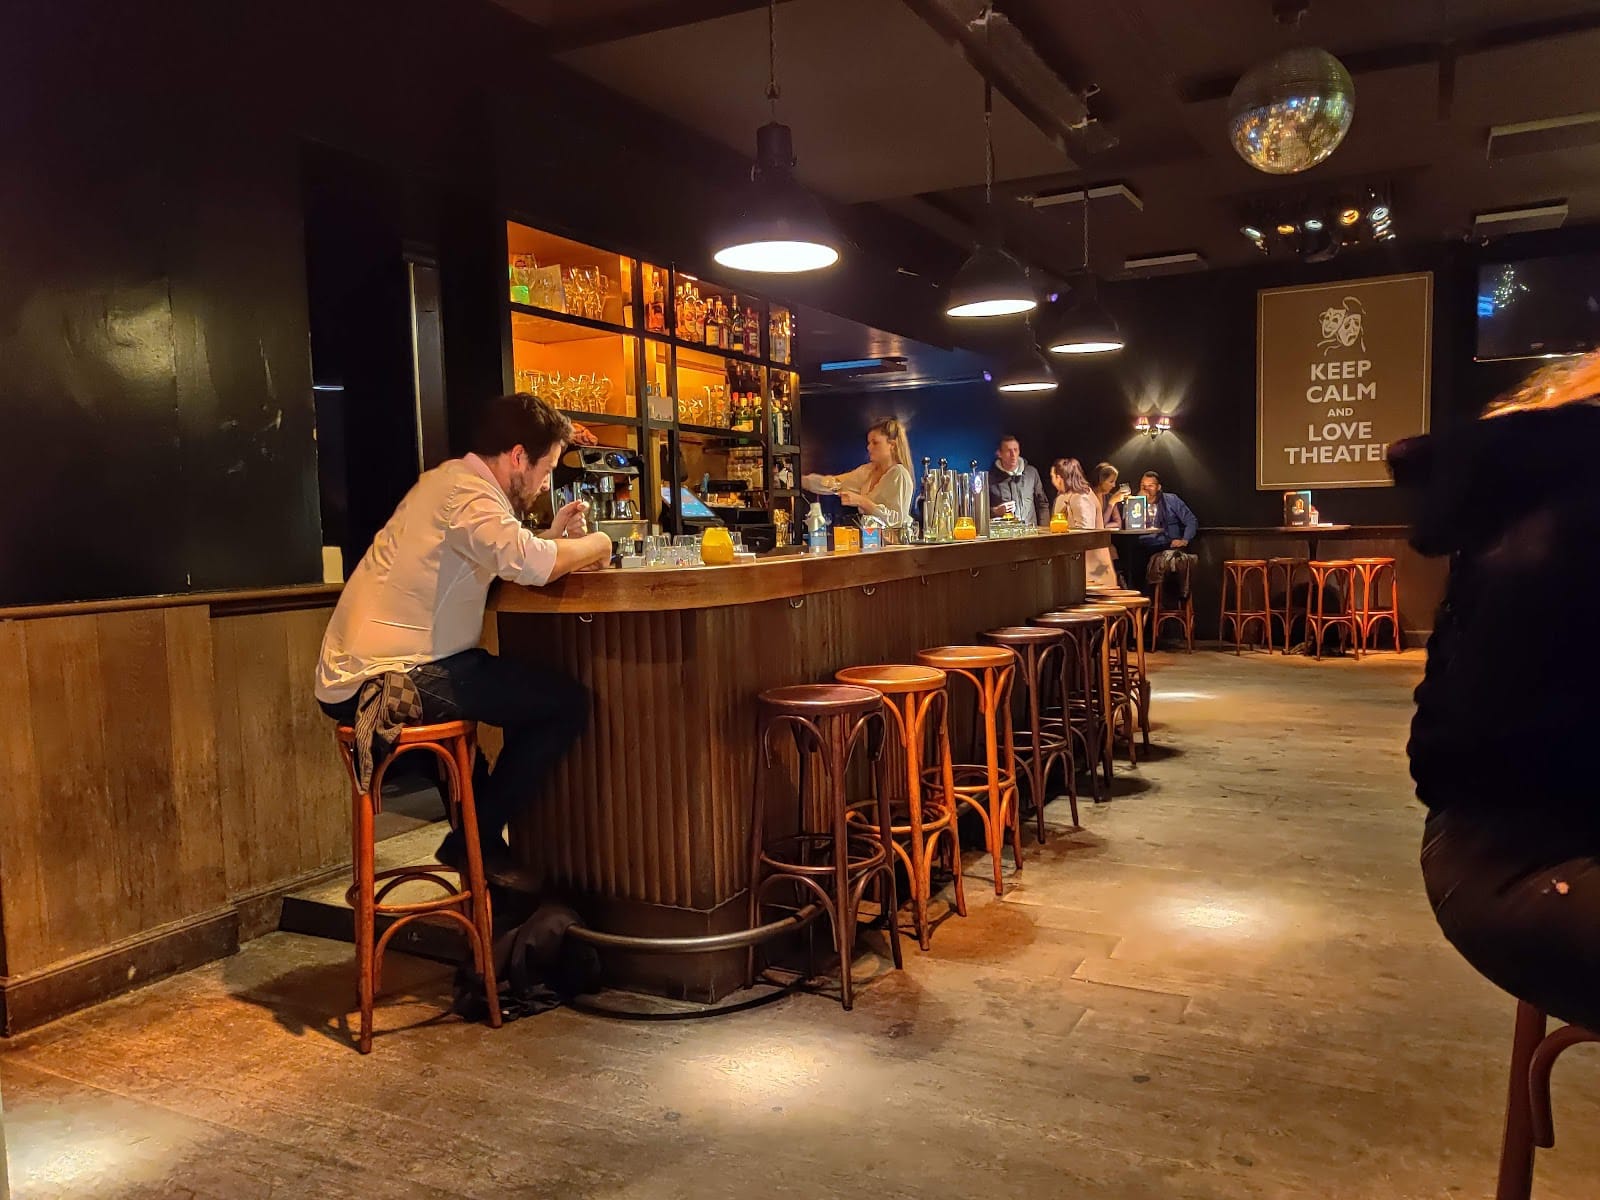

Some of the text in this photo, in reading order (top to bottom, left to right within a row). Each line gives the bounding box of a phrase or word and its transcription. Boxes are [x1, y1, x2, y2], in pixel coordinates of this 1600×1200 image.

[1310, 359, 1371, 381] KEEP
[1306, 382, 1376, 403] CALM
[1327, 407, 1354, 418] AND
[1308, 421, 1372, 442] LOVE
